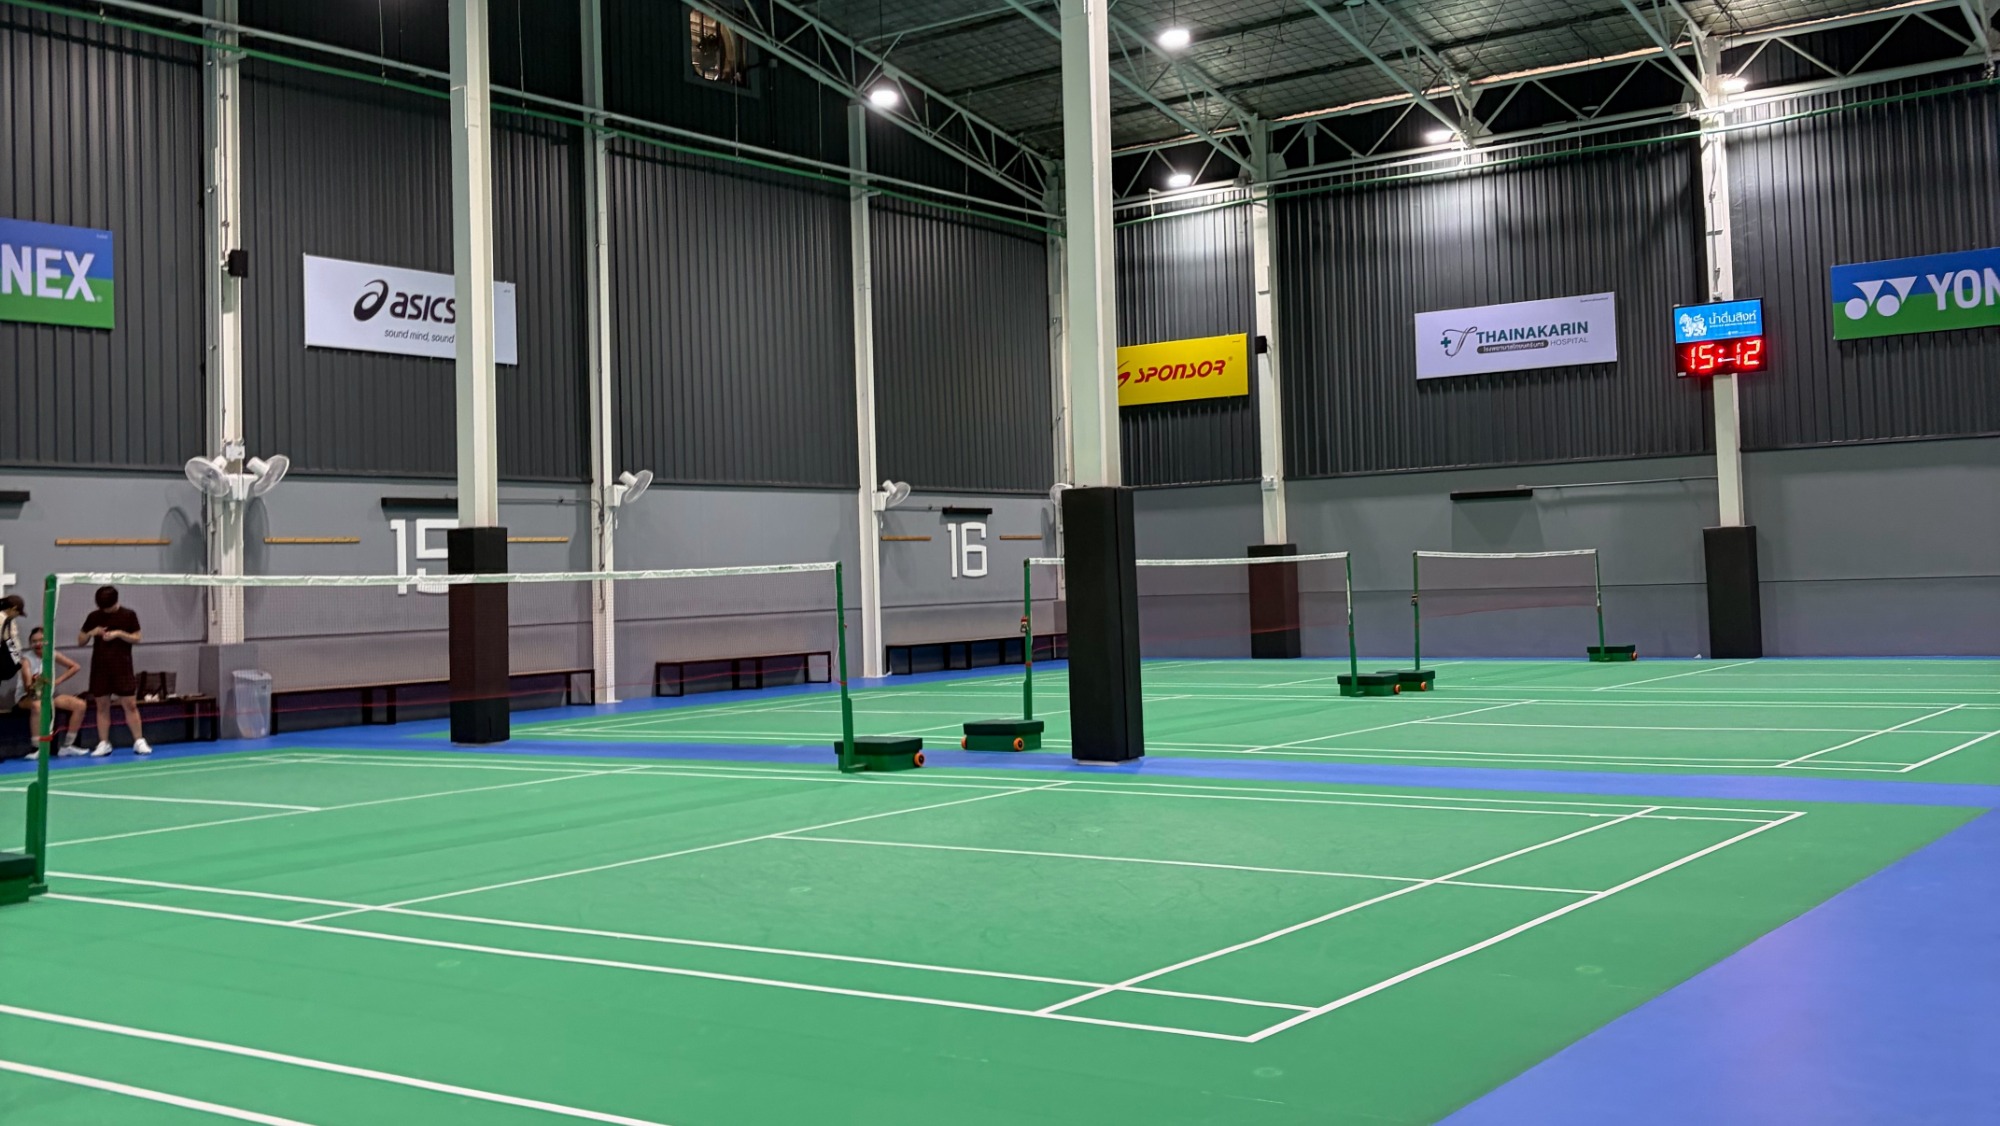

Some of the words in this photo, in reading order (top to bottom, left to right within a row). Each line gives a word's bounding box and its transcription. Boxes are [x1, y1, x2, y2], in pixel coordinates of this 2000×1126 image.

[384, 329, 409, 339] sound
[409, 332, 429, 342] mind,
[431, 334, 455, 344] sound
[1476, 321, 1589, 344] THAINAKARIN
[1550, 337, 1589, 347] HOSPITAL
[1134, 359, 1226, 384] SPONSOR
[390, 518, 459, 595] 15
[947, 521, 988, 579] 16
